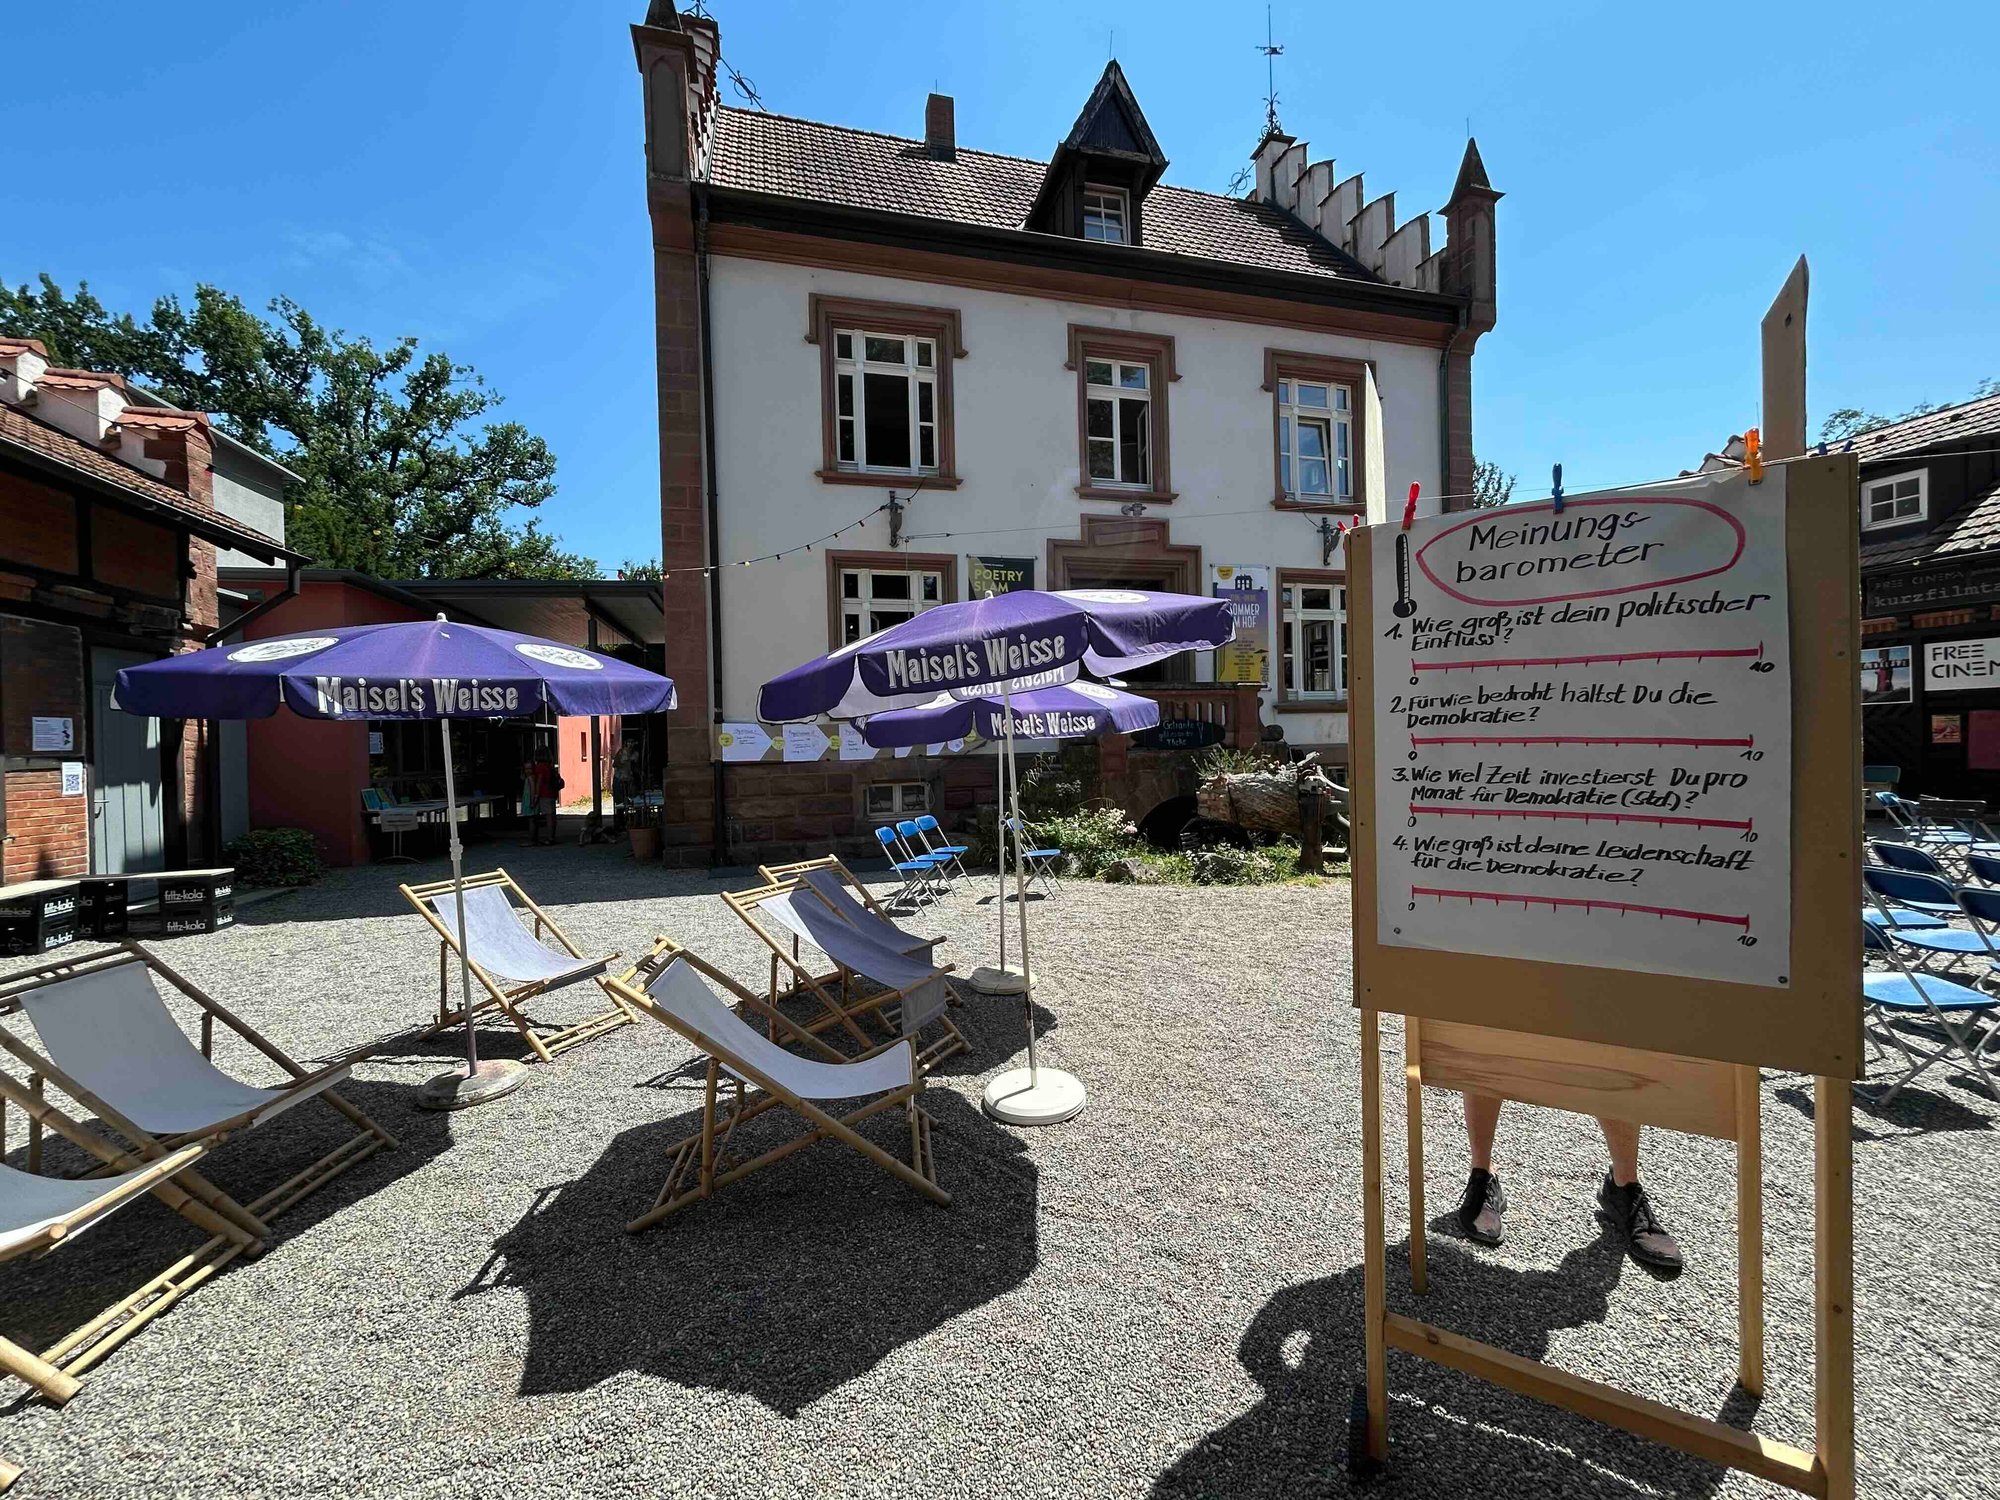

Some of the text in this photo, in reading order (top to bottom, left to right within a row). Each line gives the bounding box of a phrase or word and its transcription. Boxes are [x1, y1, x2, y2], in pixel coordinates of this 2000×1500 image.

[1456, 542, 1664, 583] barometer
[974, 569, 1024, 581] POETRY
[974, 581, 1009, 592] SLAM
[1242, 616, 1257, 628] HOF
[1384, 590, 1771, 640] 1. Wie groß ist dein politischer
[885, 633, 1066, 689] Maisel's Weisse
[1932, 643, 1985, 661] FREE
[316, 676, 519, 714] Maisel's Weisse
[1390, 696, 1407, 713] 2.
[1477, 682, 1556, 704] bedroht
[1561, 681, 1628, 703] hältst
[1632, 685, 1663, 704] Du
[1669, 682, 1719, 705] die
[1046, 712, 1096, 736] Weisse
[1408, 706, 1541, 728] Demokratie?
[1740, 750, 1764, 761] 10
[1392, 762, 1748, 794] 3. Wie viel Zeit investierst Du pro
[1411, 785, 1466, 800] Monat
[1470, 786, 1504, 802] für
[1504, 788, 1618, 805] Demokratie
[1393, 835, 1408, 851] 4.
[1414, 835, 1450, 852] Wie
[1452, 835, 1494, 858] groß
[1497, 835, 1526, 853] ist
[1525, 836, 1590, 856] deine
[1740, 831, 1758, 842] 10
[1411, 852, 1645, 887] für die Demokratie?
[1737, 935, 1758, 947] 10
